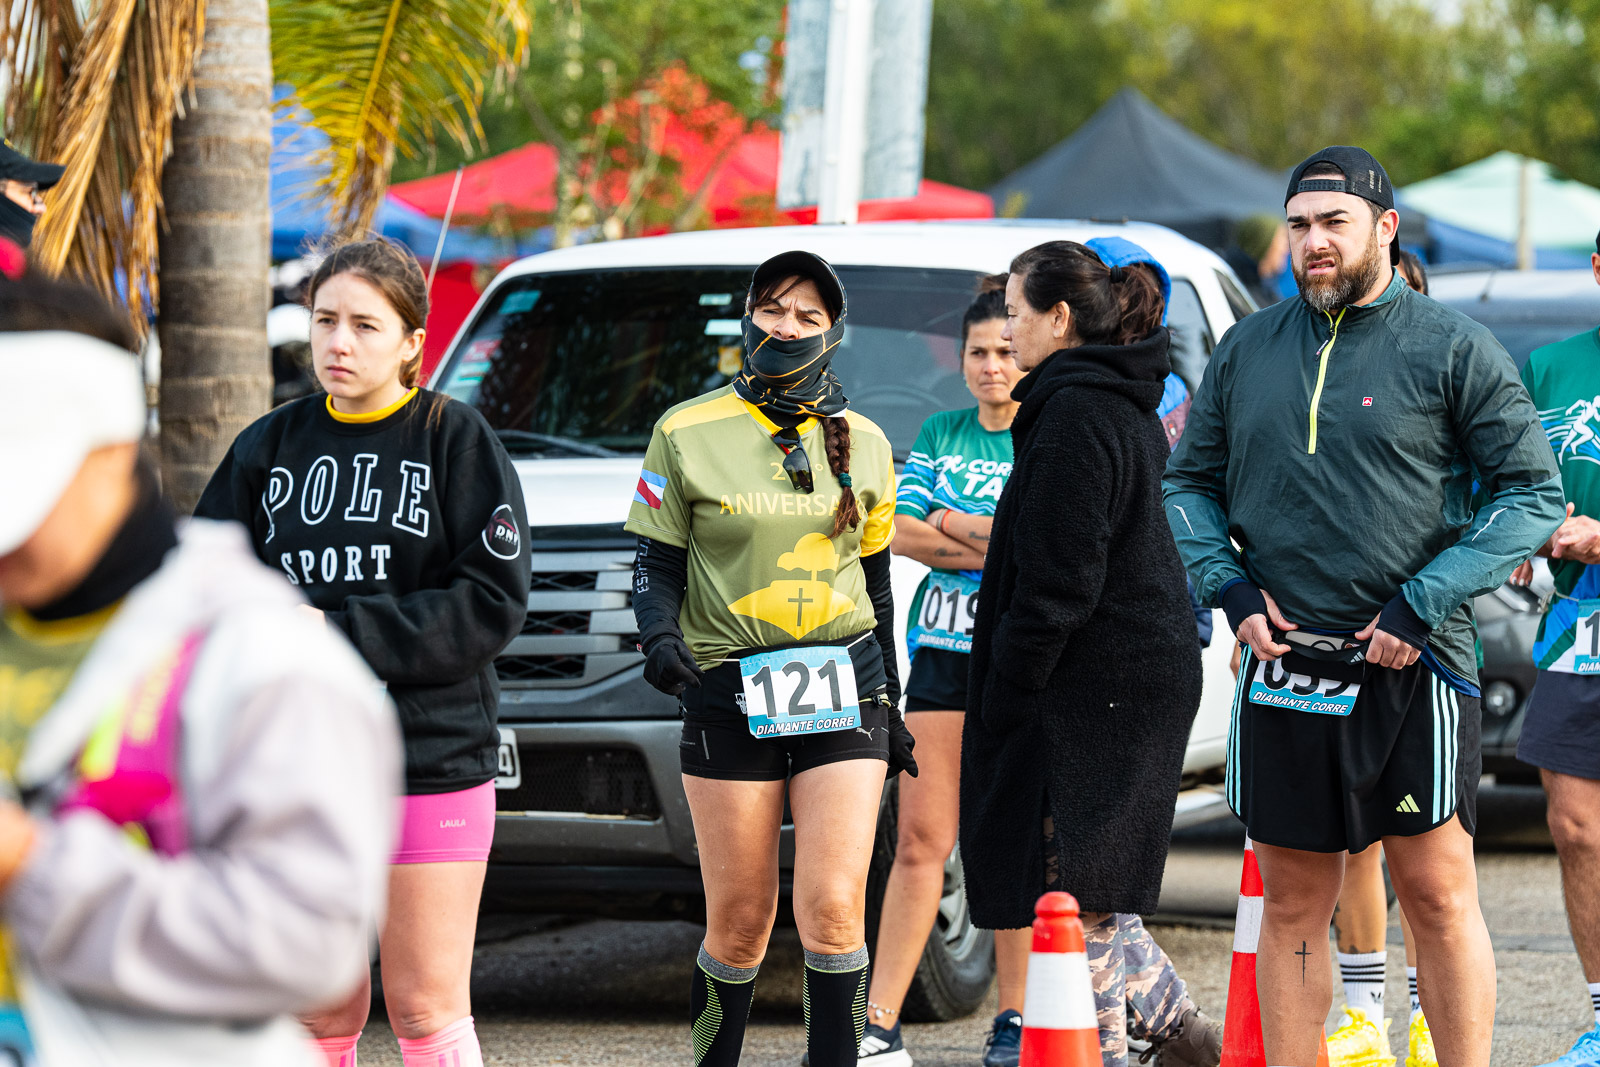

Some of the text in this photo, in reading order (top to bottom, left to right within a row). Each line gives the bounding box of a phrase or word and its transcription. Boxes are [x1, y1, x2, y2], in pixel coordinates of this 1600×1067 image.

[968, 458, 1012, 477] COR
[262, 453, 430, 544] POLE
[281, 545, 391, 585] SPORT
[751, 659, 843, 718] 121
[1253, 691, 1349, 714] DIAMANTE CORRE
[756, 716, 855, 735] DIAMANTE CORRE
[440, 819, 466, 828] LAULA
